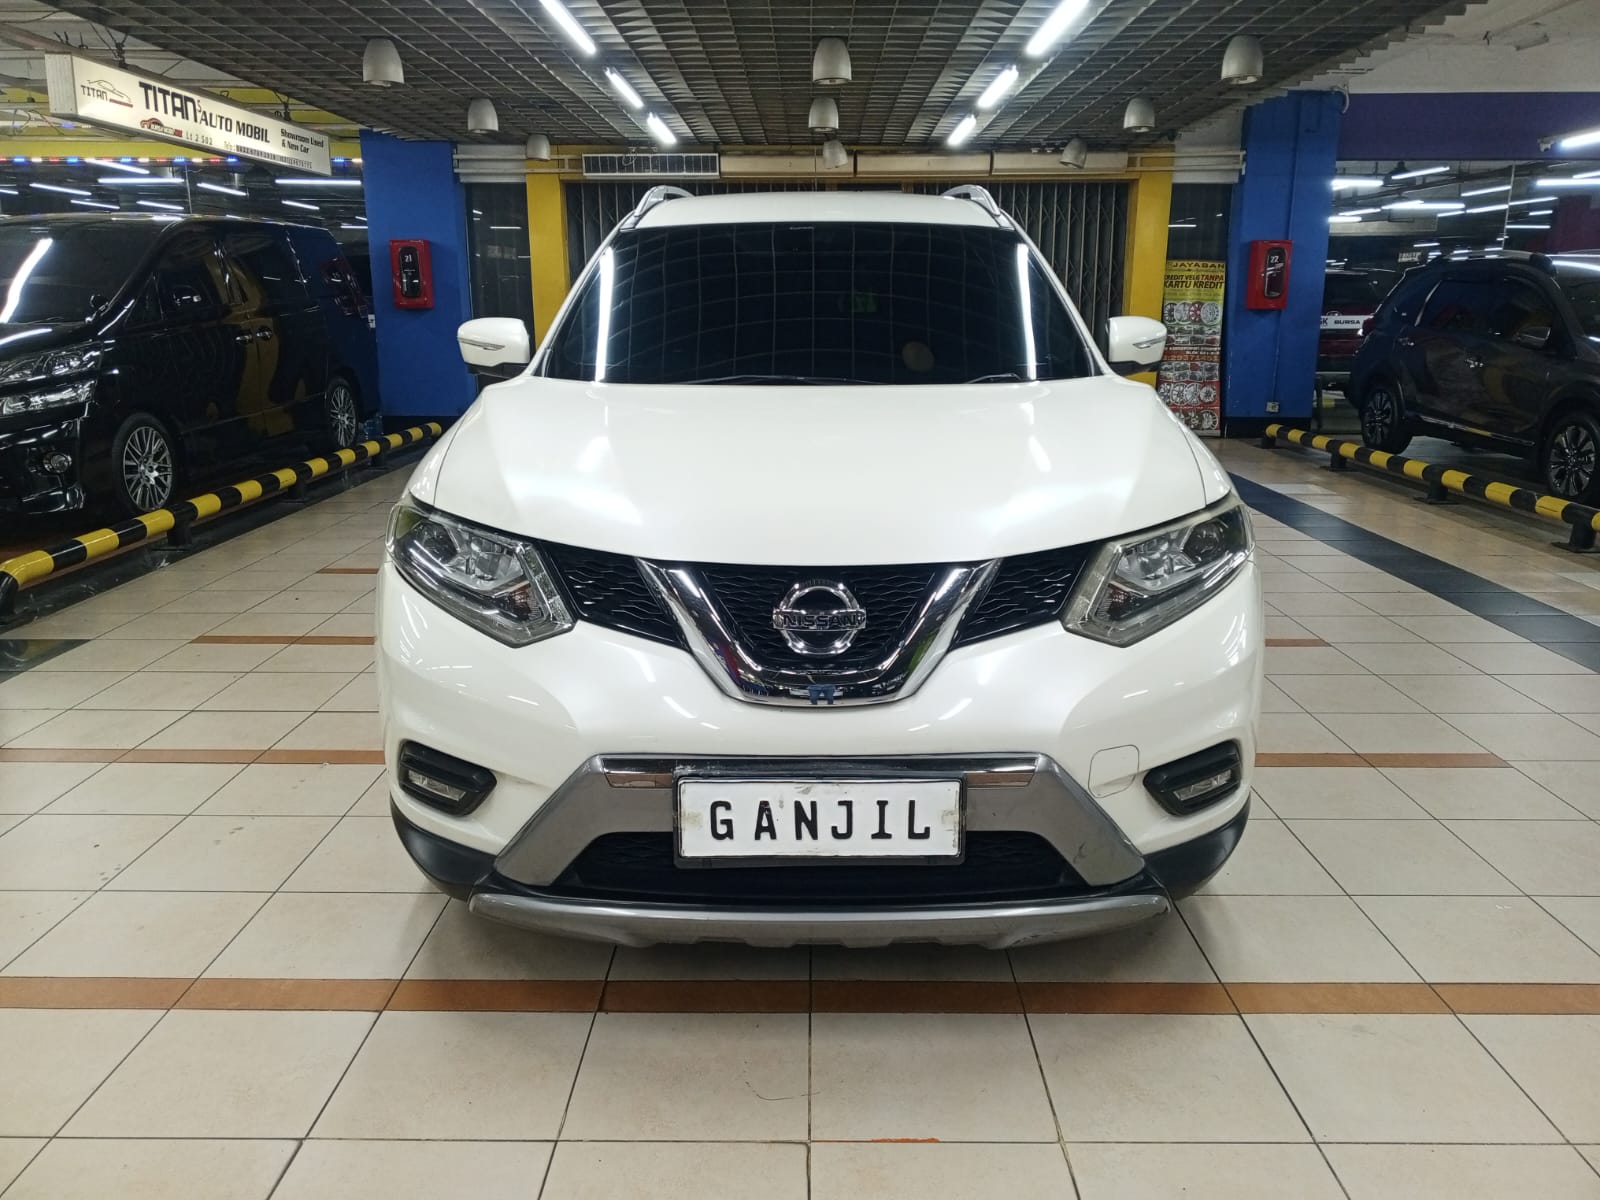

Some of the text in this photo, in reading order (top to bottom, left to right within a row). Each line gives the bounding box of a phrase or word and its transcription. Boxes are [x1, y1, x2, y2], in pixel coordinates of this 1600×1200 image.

[80, 84, 108, 101] TITAN
[199, 110, 233, 132] AUTO
[235, 120, 270, 143] MOBIL
[280, 128, 324, 148] Showroom Used
[287, 141, 299, 152] New
[300, 144, 310, 154] Car
[404, 254, 412, 262] 21
[1270, 255, 1280, 263] 22
[1164, 280, 1225, 289] KARTU KREDIT
[783, 613, 858, 629] NISSAN
[709, 799, 931, 841] GANJIL
